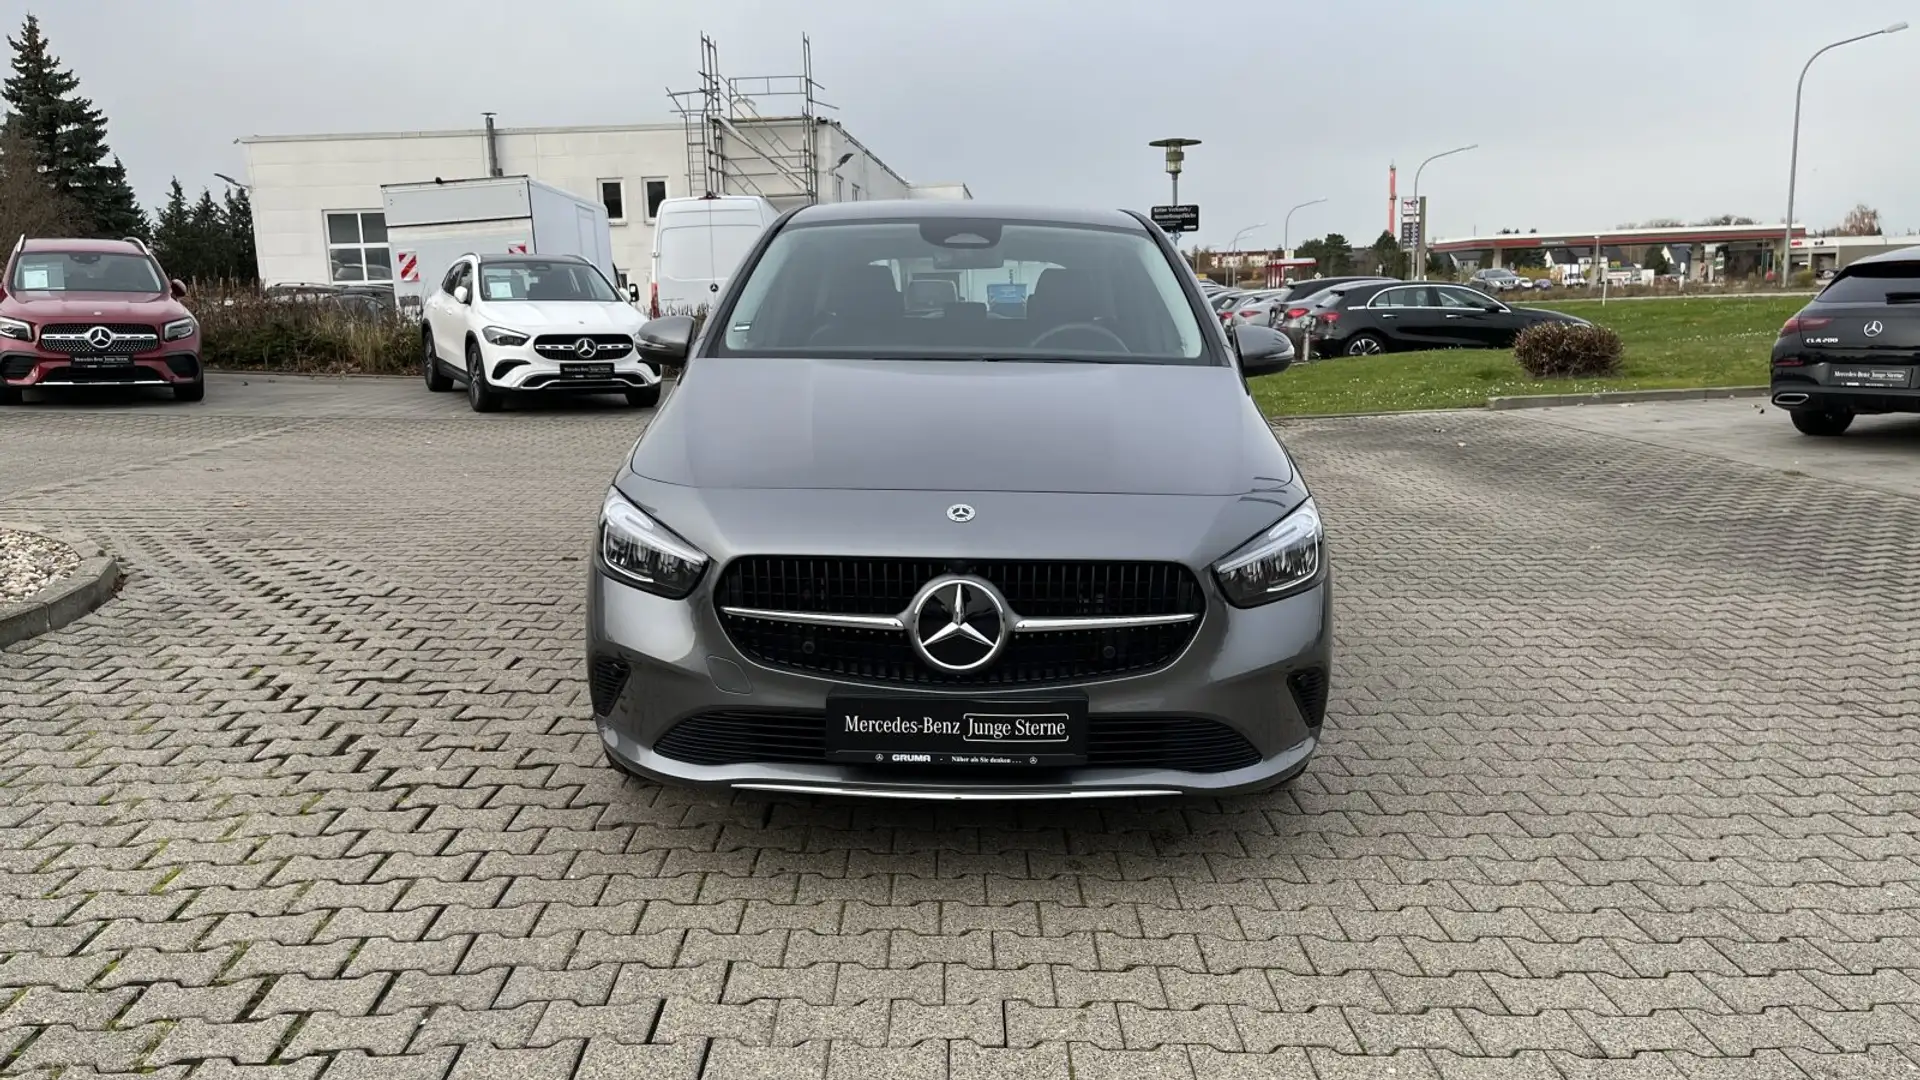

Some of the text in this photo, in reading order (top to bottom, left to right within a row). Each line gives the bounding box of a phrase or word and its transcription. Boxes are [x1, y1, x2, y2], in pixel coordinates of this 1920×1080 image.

[844, 715, 1067, 739] Mercedes-Benz Junge Sterne
[891, 753, 932, 762] GRUMA
